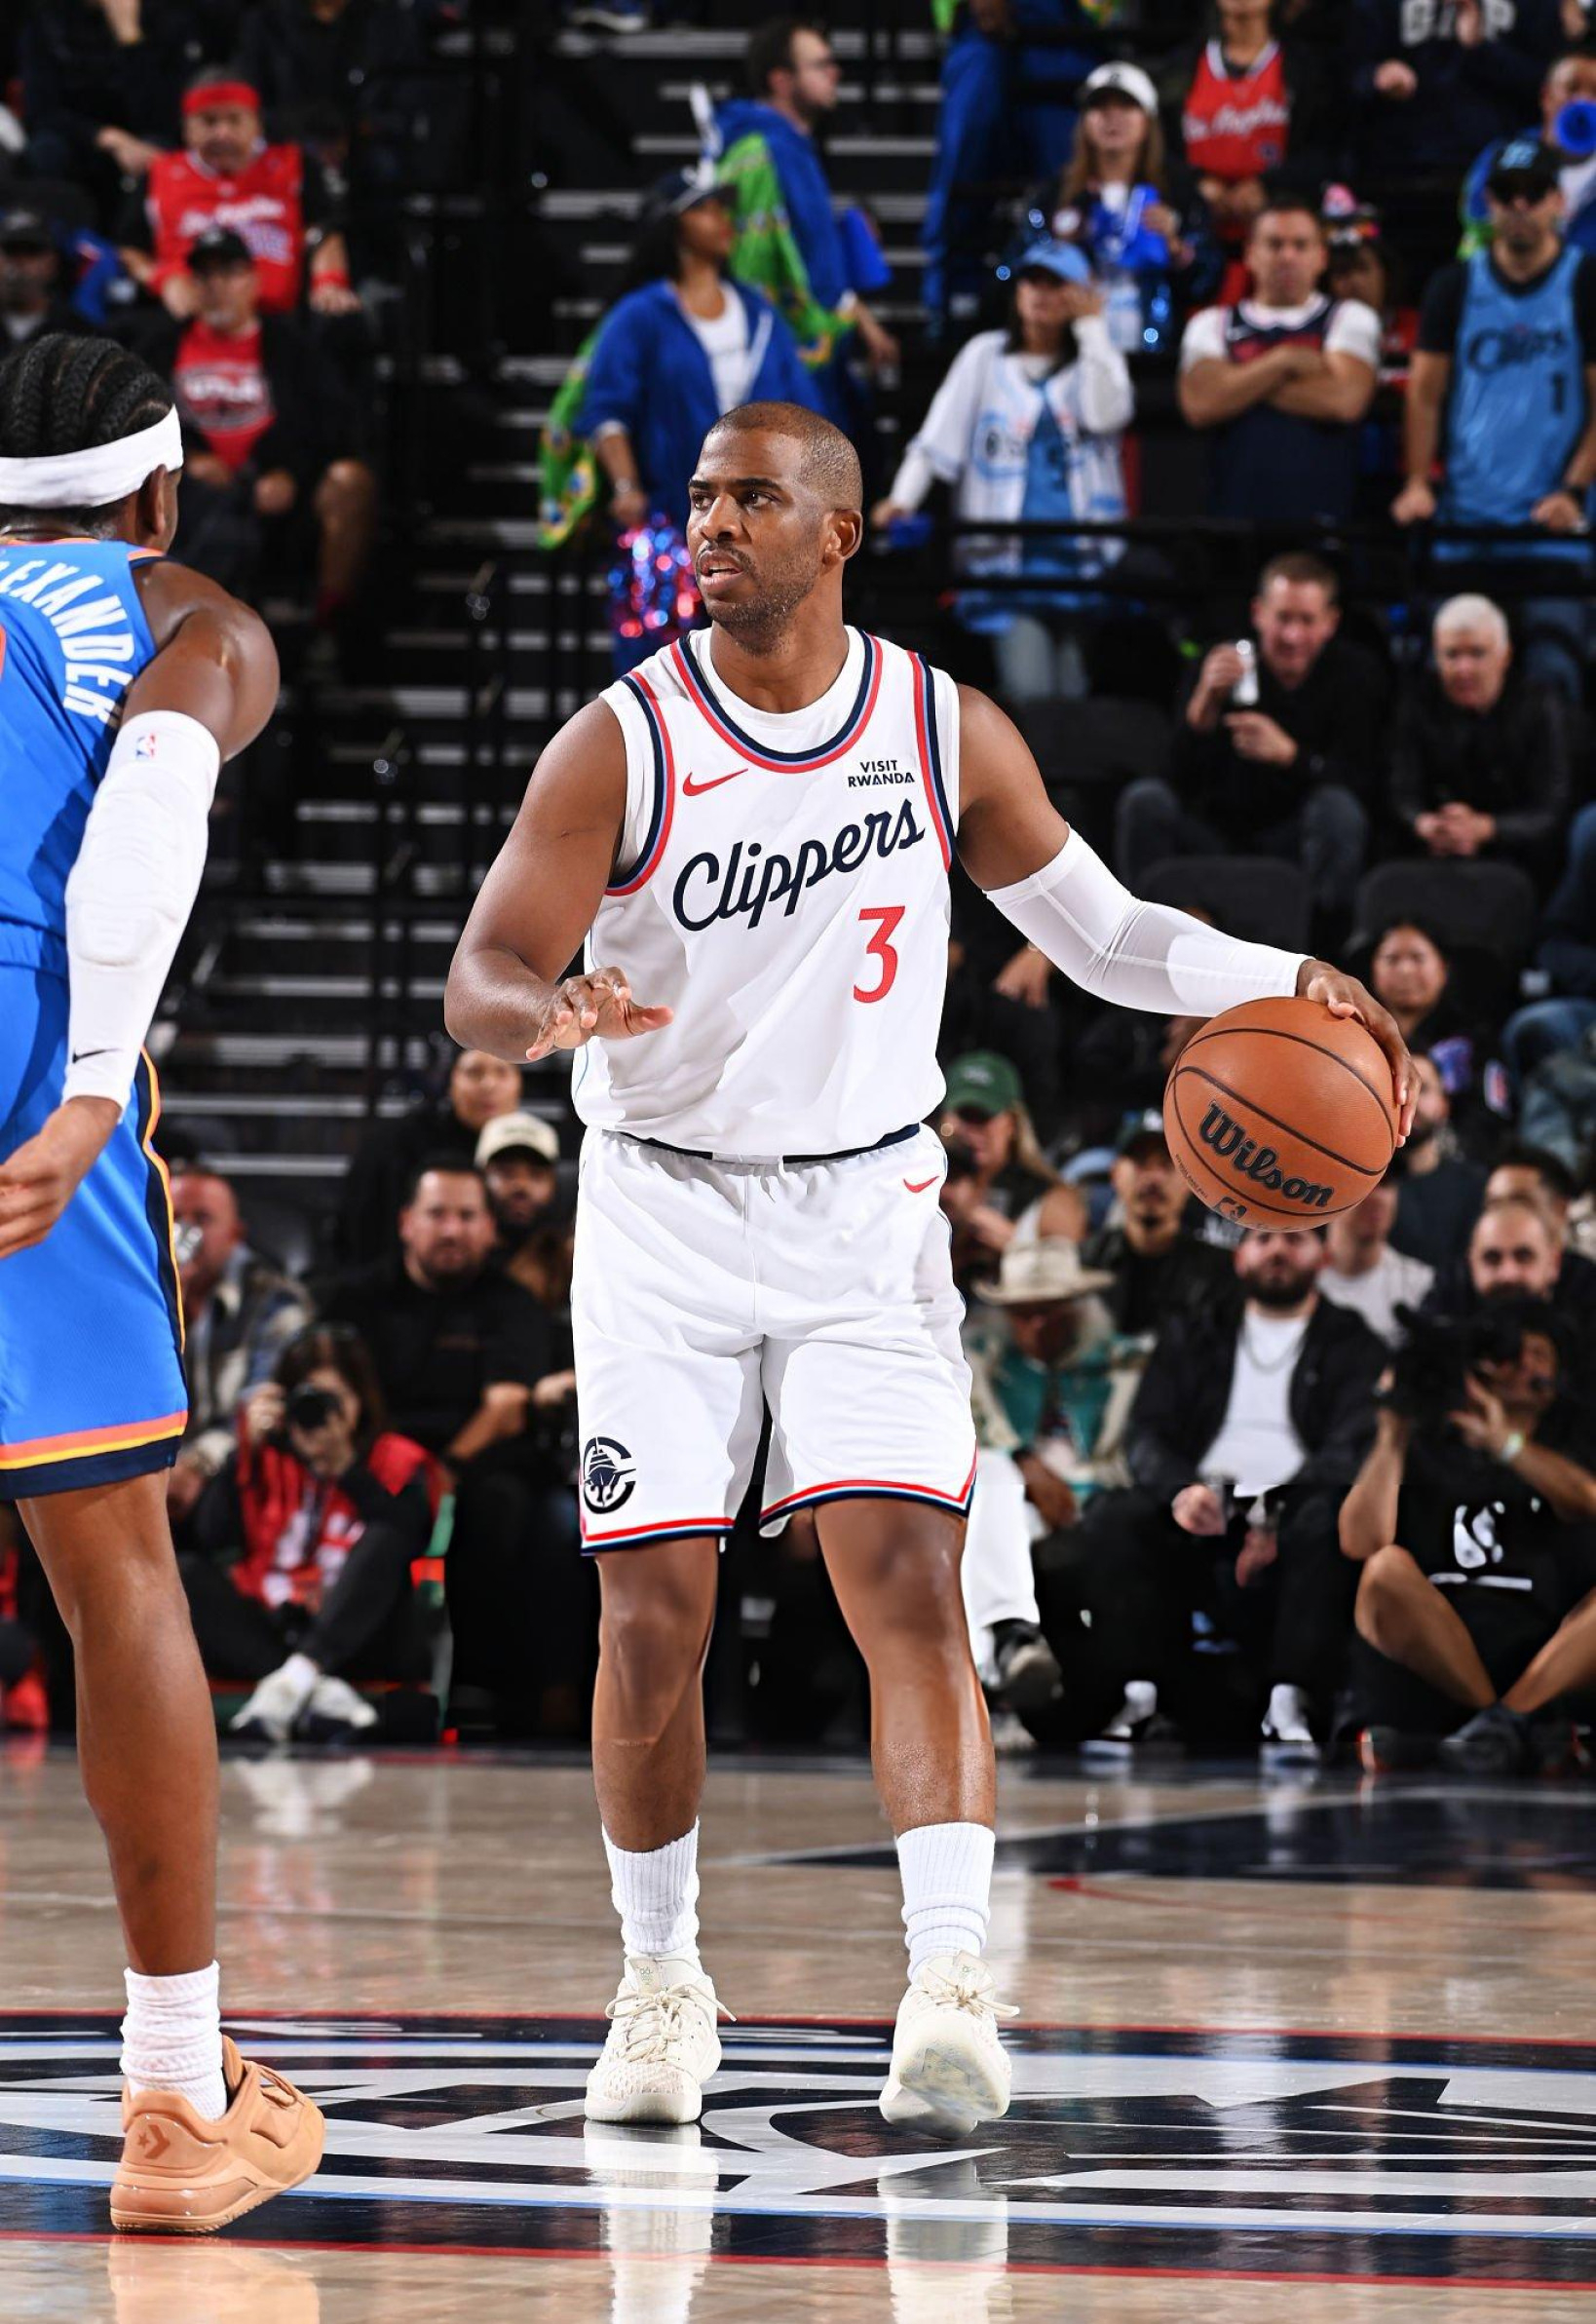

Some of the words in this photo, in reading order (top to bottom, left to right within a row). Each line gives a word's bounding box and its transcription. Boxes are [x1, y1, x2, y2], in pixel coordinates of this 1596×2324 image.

[0, 559, 135, 727] EXANDER
[848, 773, 915, 787] RWANDA
[859, 760, 897, 774] VISIT
[672, 798, 926, 932] Clippers
[854, 905, 906, 1003] 3
[1199, 1101, 1334, 1207] Wilson
